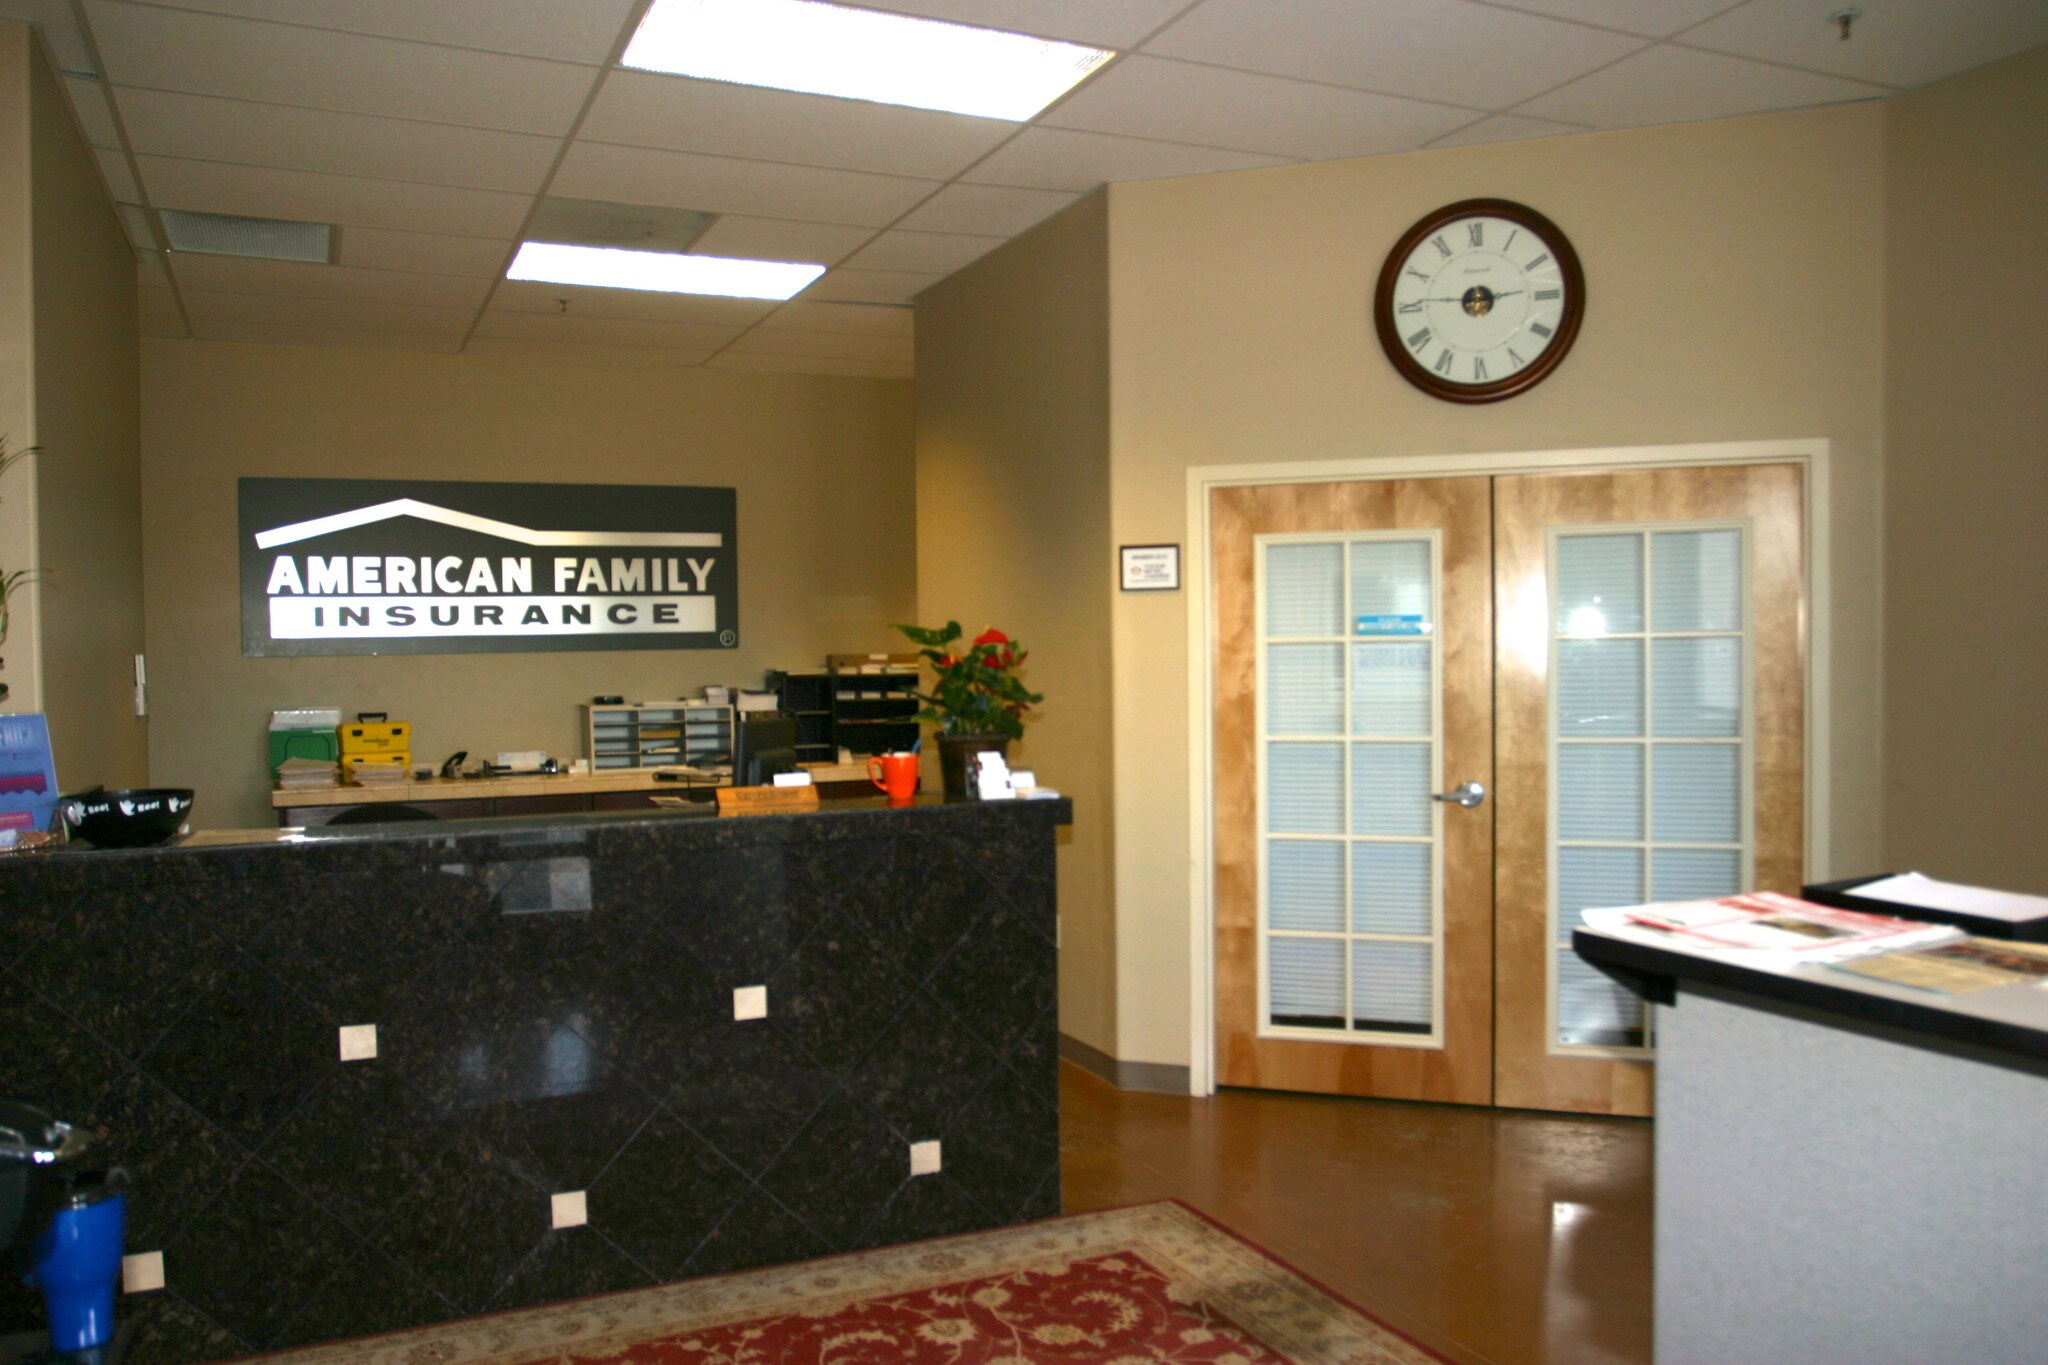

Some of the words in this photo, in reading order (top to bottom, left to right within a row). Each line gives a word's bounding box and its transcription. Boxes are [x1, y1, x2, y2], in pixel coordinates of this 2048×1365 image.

[1525, 253, 1548, 272] II
[1534, 289, 1560, 301] III
[267, 555, 533, 594] AMERICAN
[553, 557, 716, 593] FAMILY
[314, 603, 680, 627] INSURANCE
